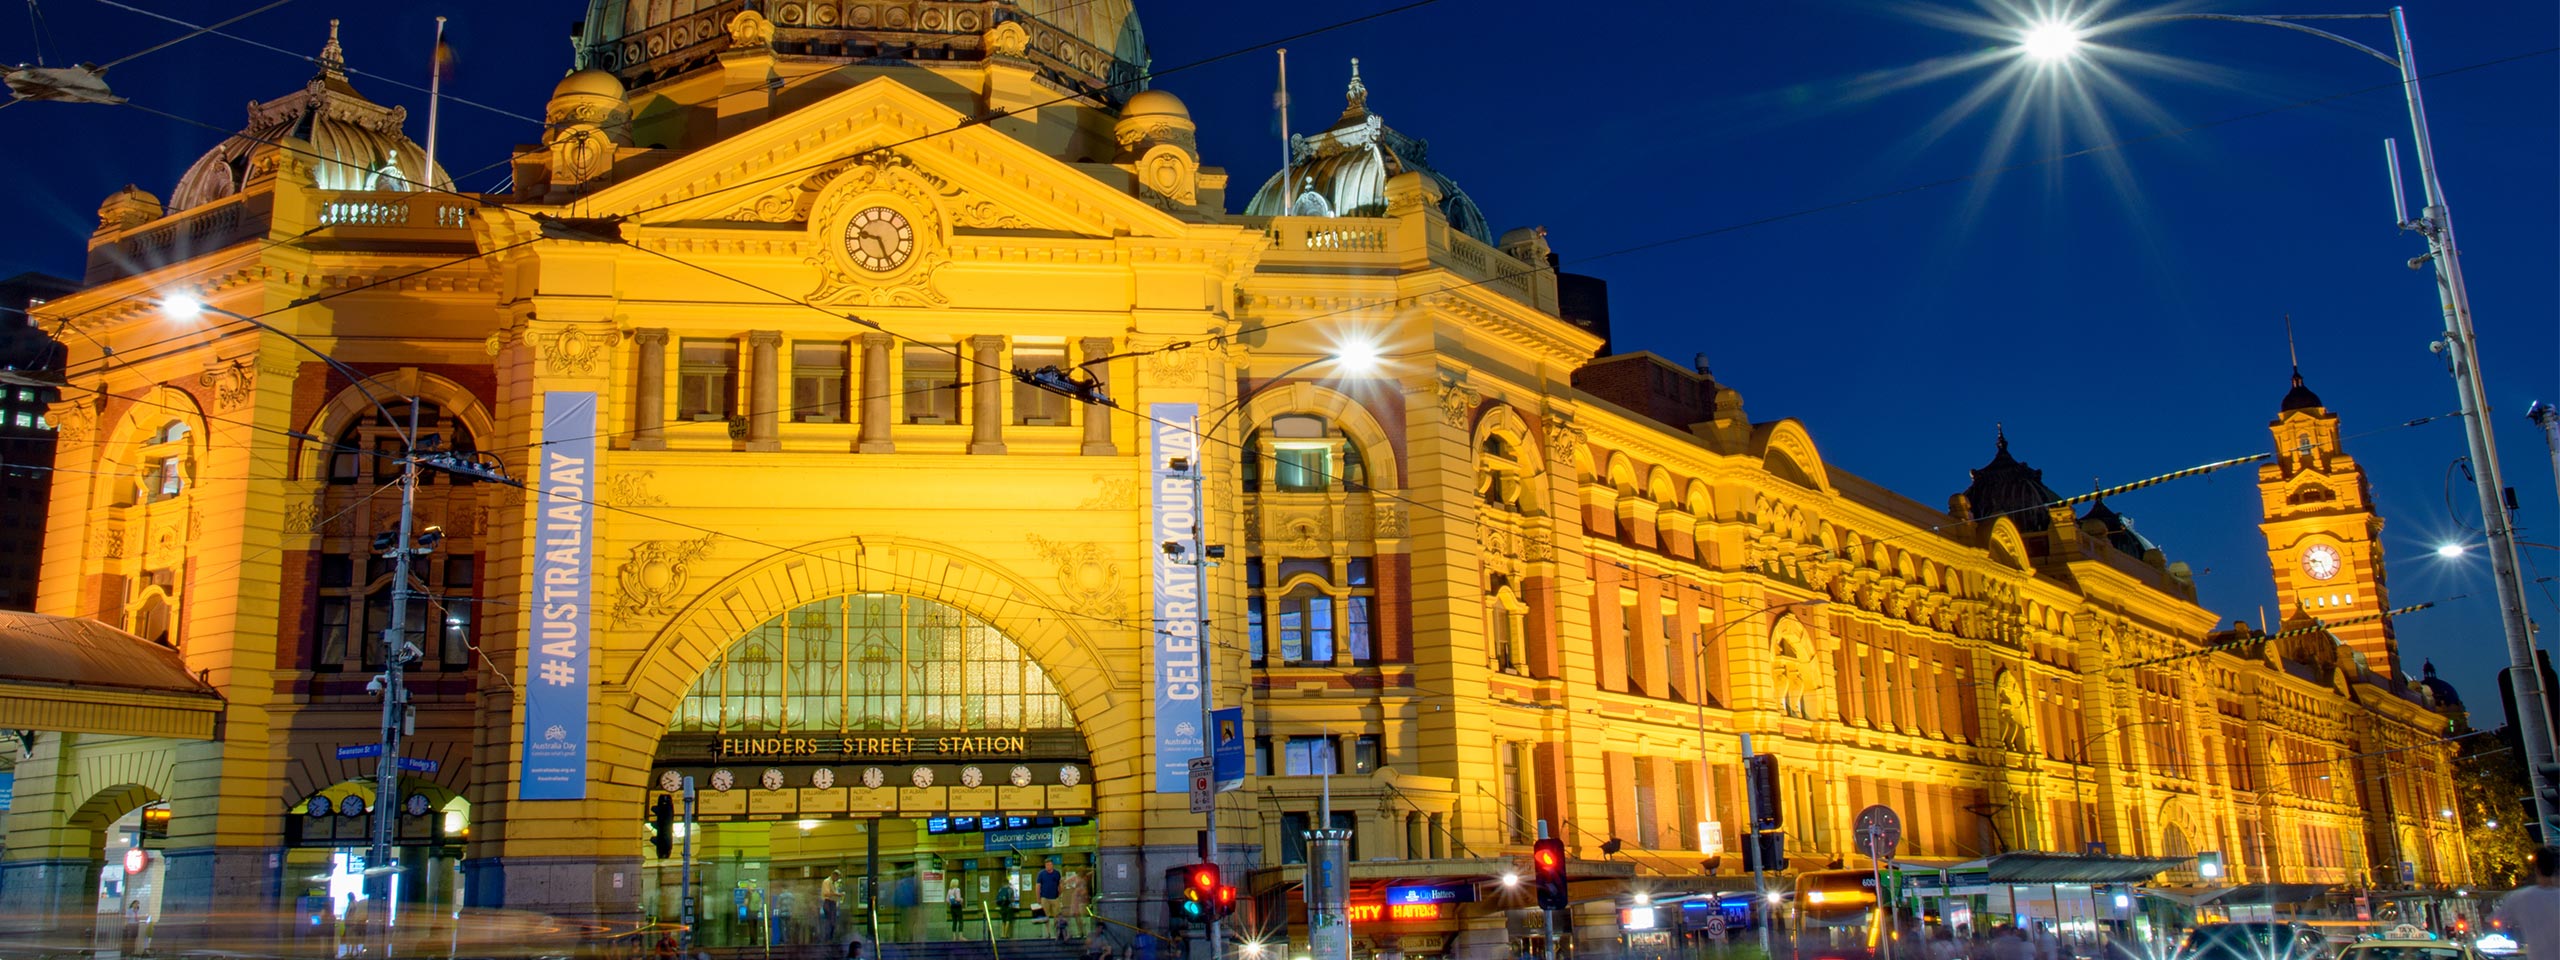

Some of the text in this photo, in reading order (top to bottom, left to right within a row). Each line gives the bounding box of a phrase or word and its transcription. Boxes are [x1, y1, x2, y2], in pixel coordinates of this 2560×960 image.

[1159, 416, 1199, 701] CELEBRATE YOUR WAY
[540, 452, 585, 687] #AUSTRALIADAY
[531, 742, 577, 751] Australia Day
[722, 736, 1024, 754] FLINDERS STREET STATION
[991, 832, 1052, 844] Customer Service
[1349, 904, 1437, 919] CITY HATTERS
[1710, 922, 1721, 931] 40
